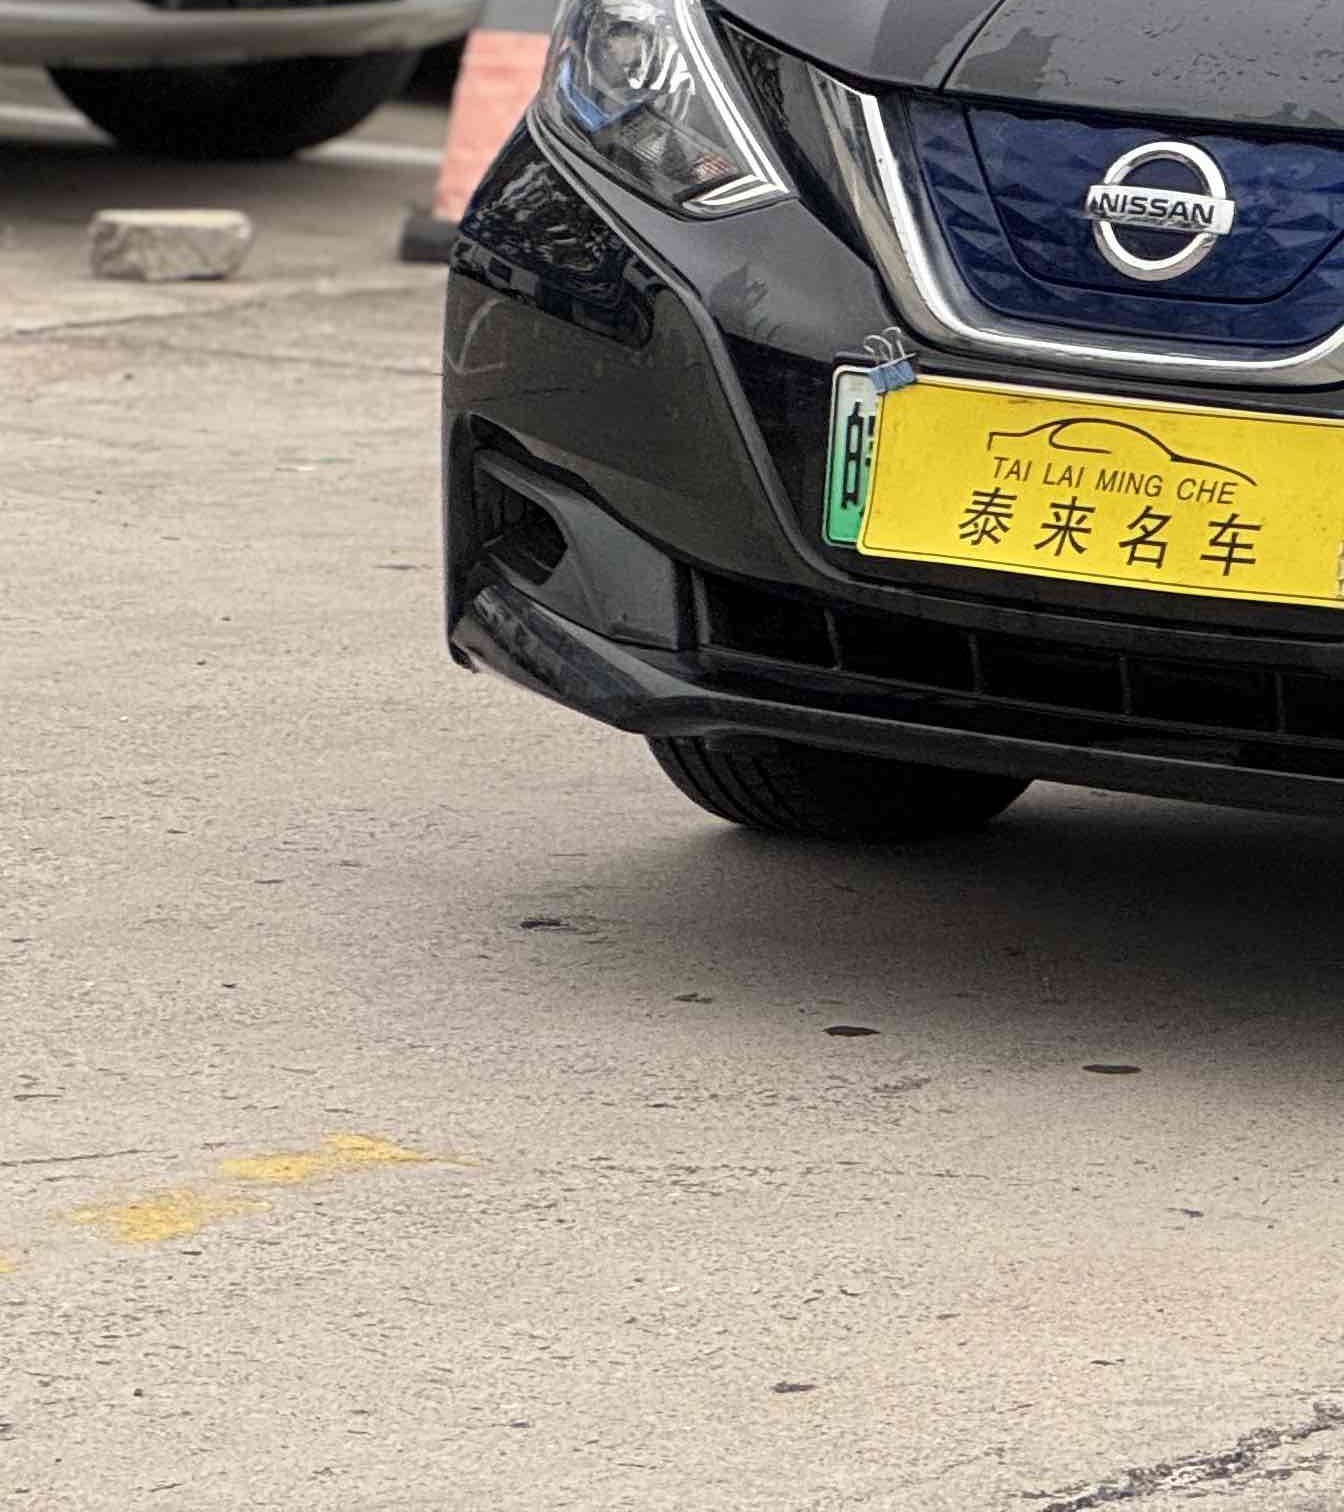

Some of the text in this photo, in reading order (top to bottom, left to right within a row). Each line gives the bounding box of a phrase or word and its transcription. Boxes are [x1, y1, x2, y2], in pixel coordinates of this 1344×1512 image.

[1100, 192, 1215, 225] NISSAN
[992, 455, 1239, 505] TAI LAI MING CHE
[957, 486, 1262, 577] 泰来名车
